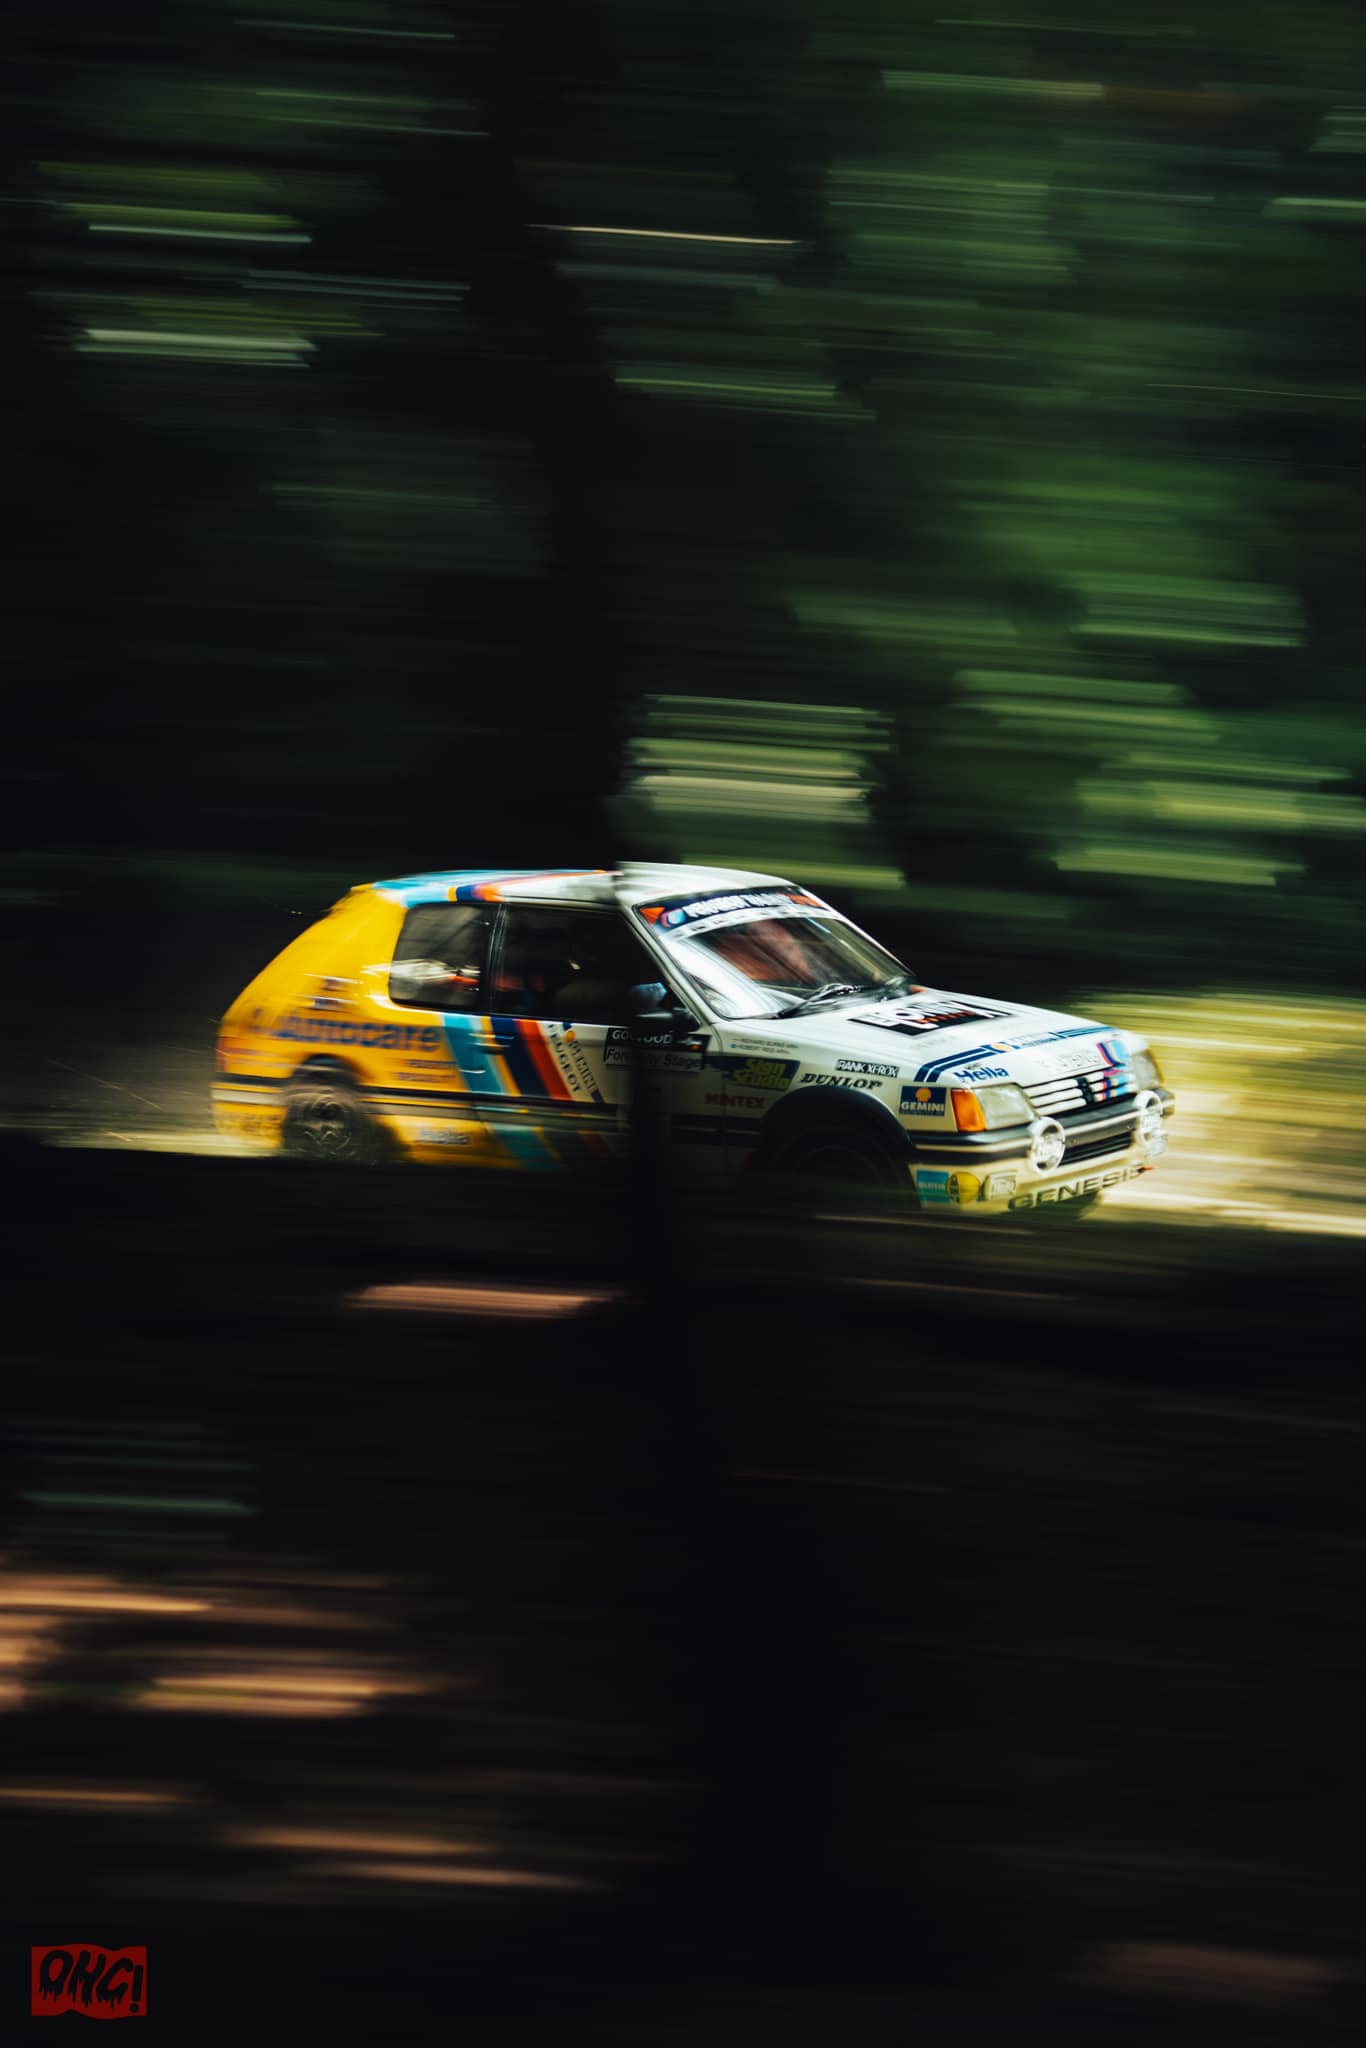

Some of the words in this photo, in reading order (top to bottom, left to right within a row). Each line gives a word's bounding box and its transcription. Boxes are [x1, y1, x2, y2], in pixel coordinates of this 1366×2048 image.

[839, 1060, 867, 1073] RANK
[953, 1066, 1009, 1082] Hella
[801, 1073, 883, 1090] DUNLOP
[900, 1101, 945, 1112] GEMINI
[1008, 1162, 1140, 1211] GENESIS
